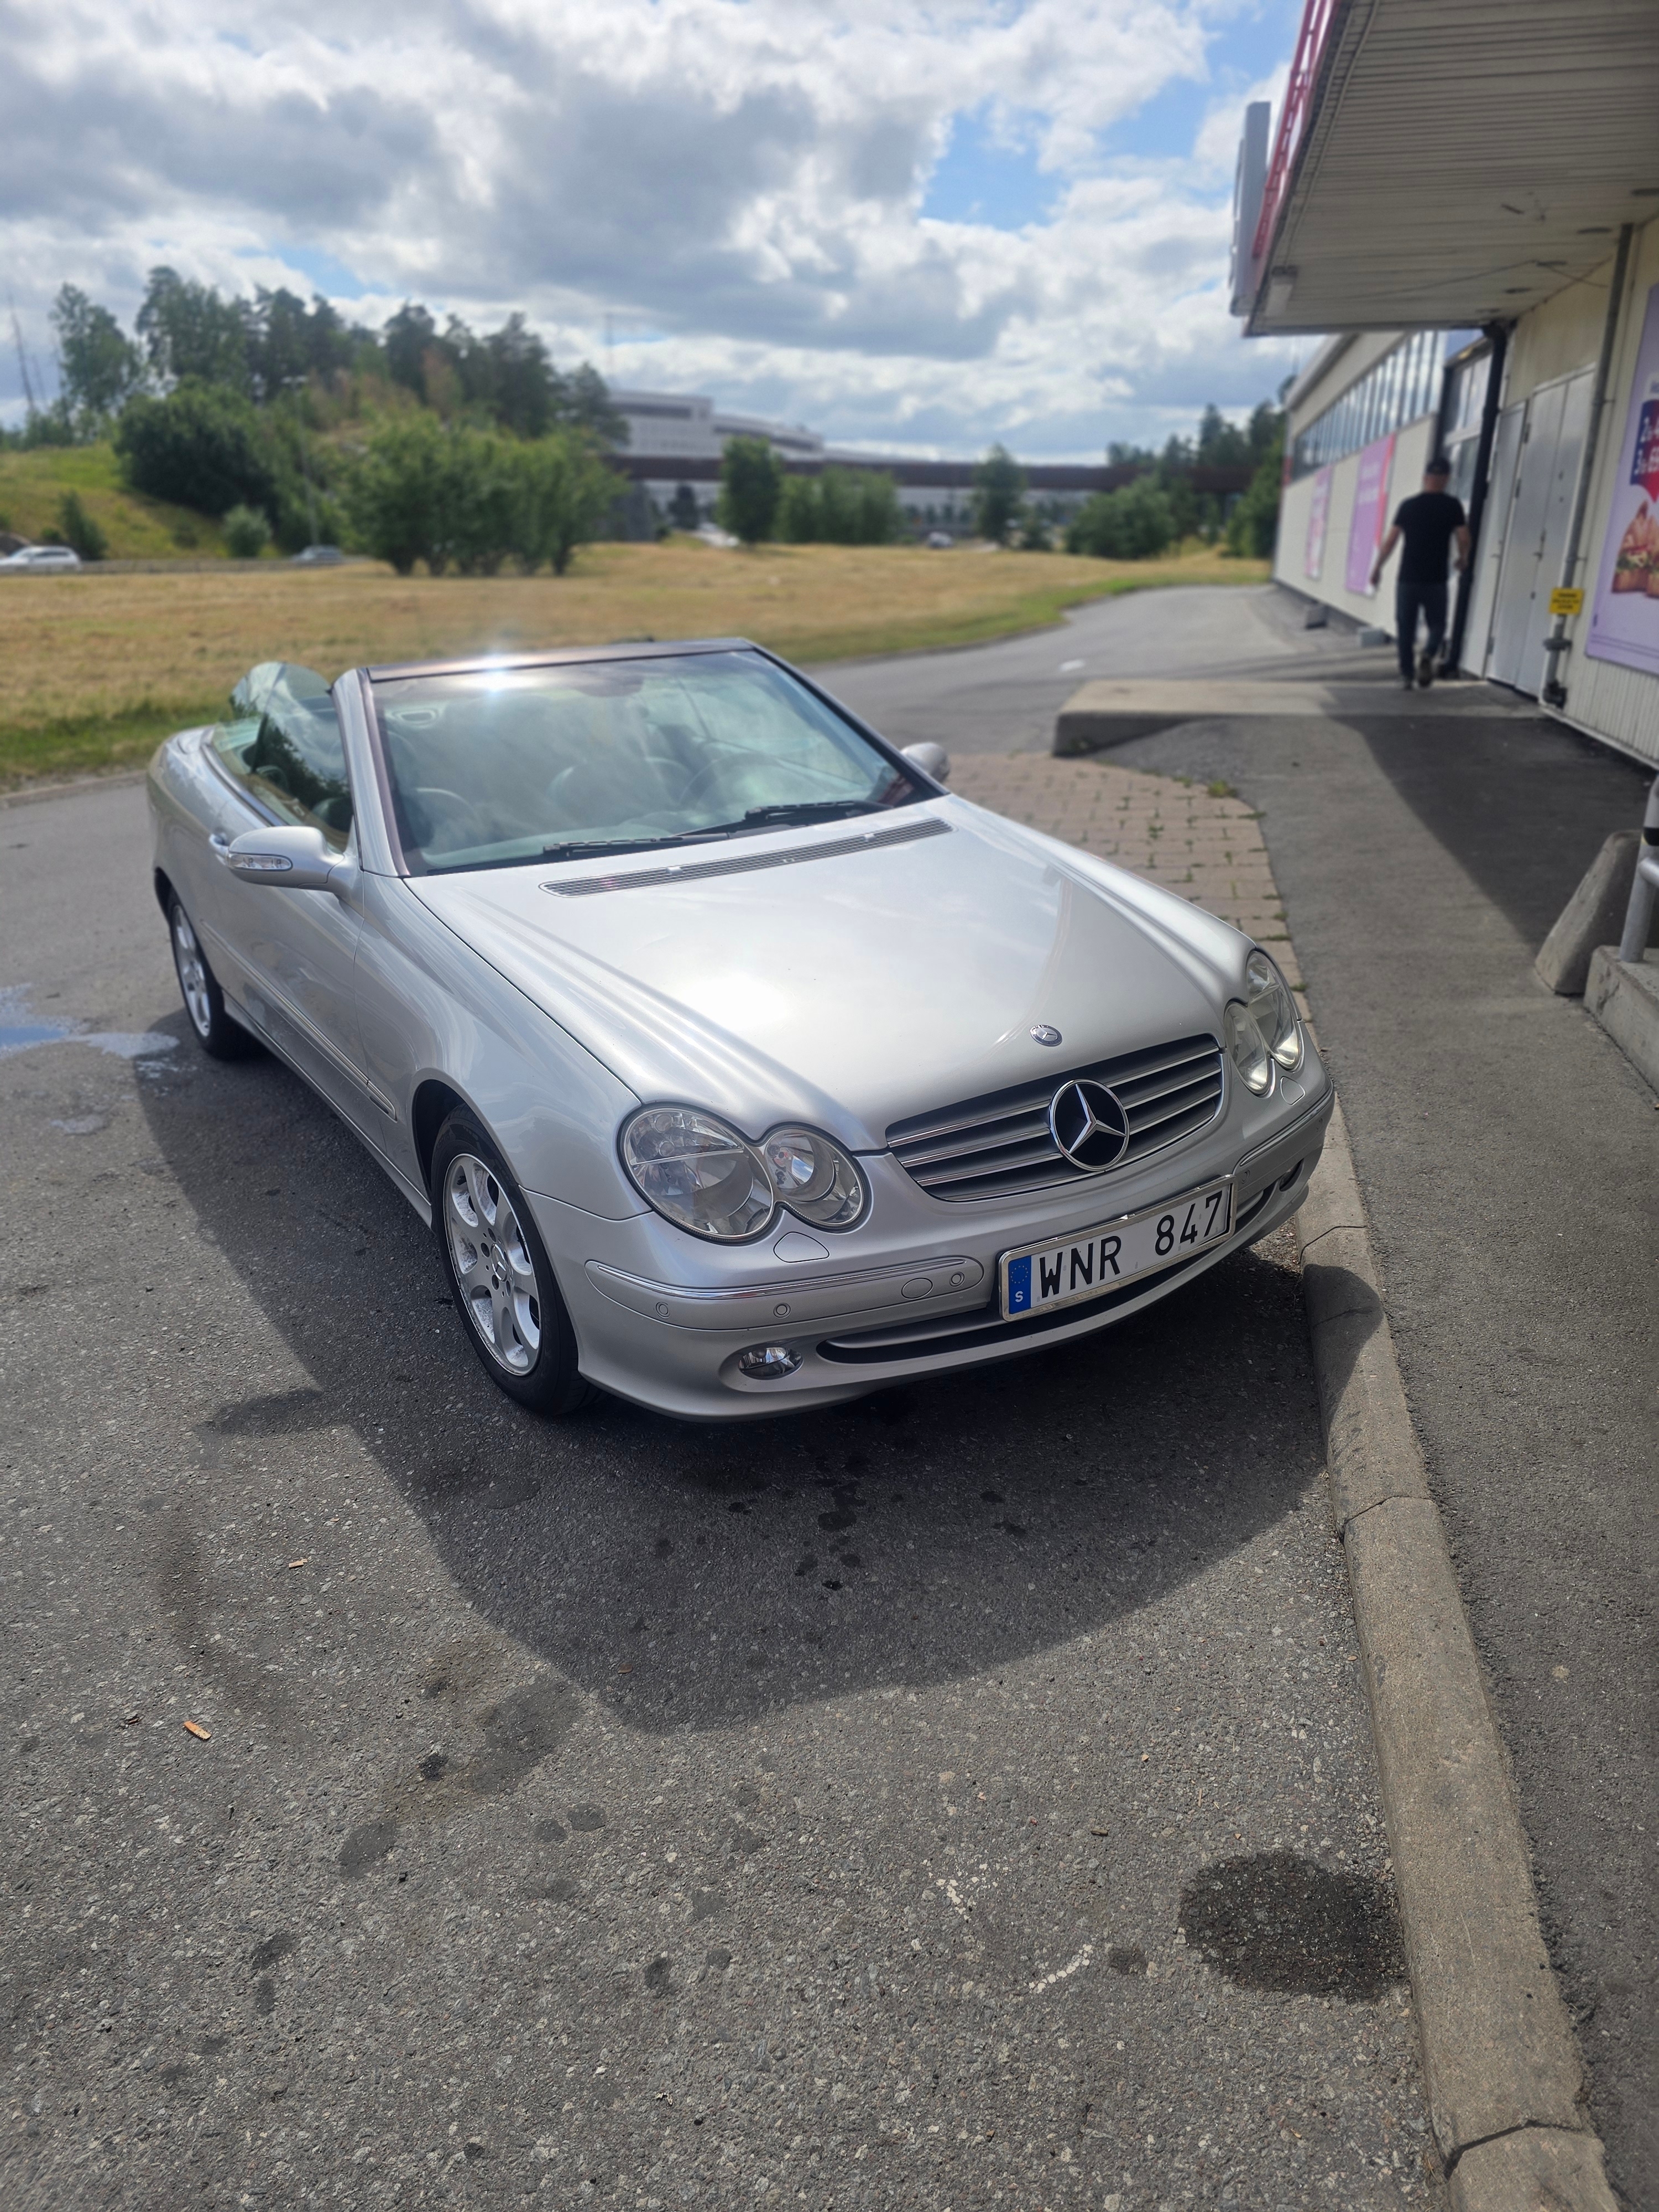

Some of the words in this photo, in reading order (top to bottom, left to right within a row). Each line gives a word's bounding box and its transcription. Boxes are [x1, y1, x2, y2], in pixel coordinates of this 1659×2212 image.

[1015, 1291, 1024, 1302] S
[1039, 1235, 1122, 1298] WNR
[1155, 1190, 1223, 1256] 847
